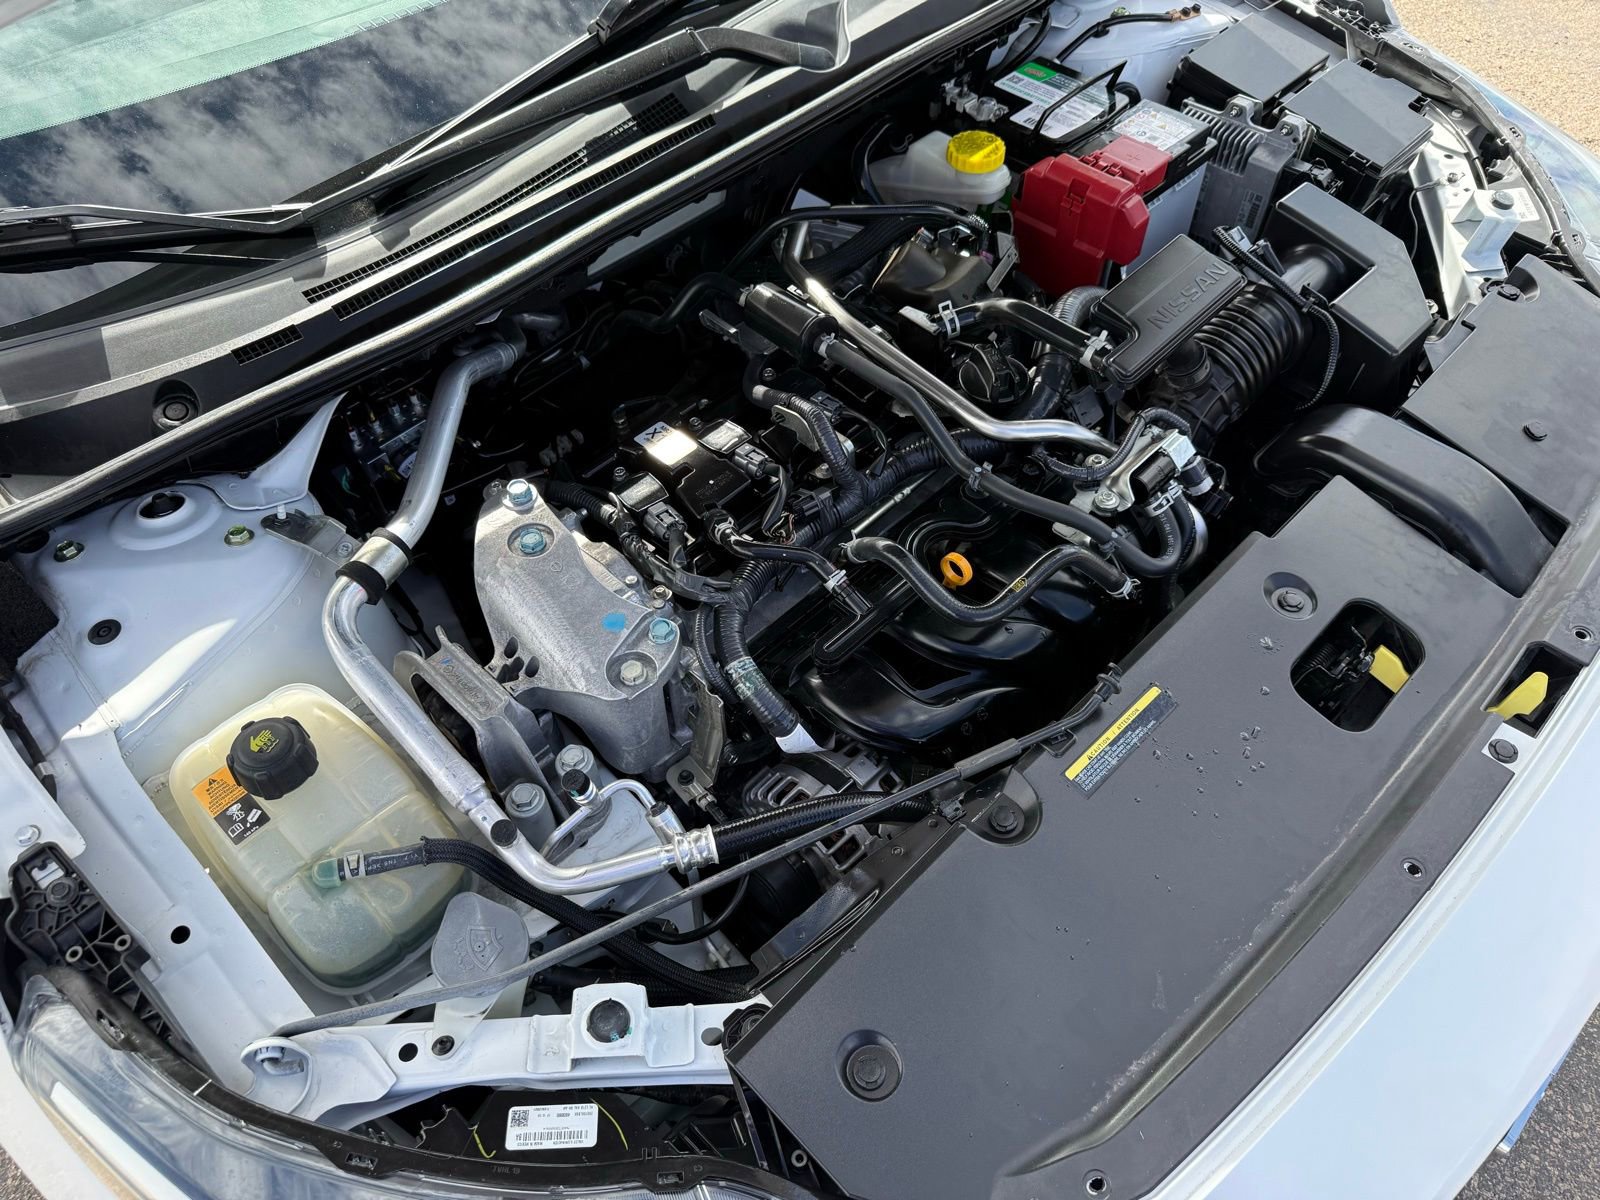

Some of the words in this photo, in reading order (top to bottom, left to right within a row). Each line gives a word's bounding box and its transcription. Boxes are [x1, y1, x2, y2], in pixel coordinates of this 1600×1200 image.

[1147, 262, 1229, 330] NISSAN
[1090, 736, 1111, 756] CAUTION
[1116, 707, 1140, 731] ATTENTION
